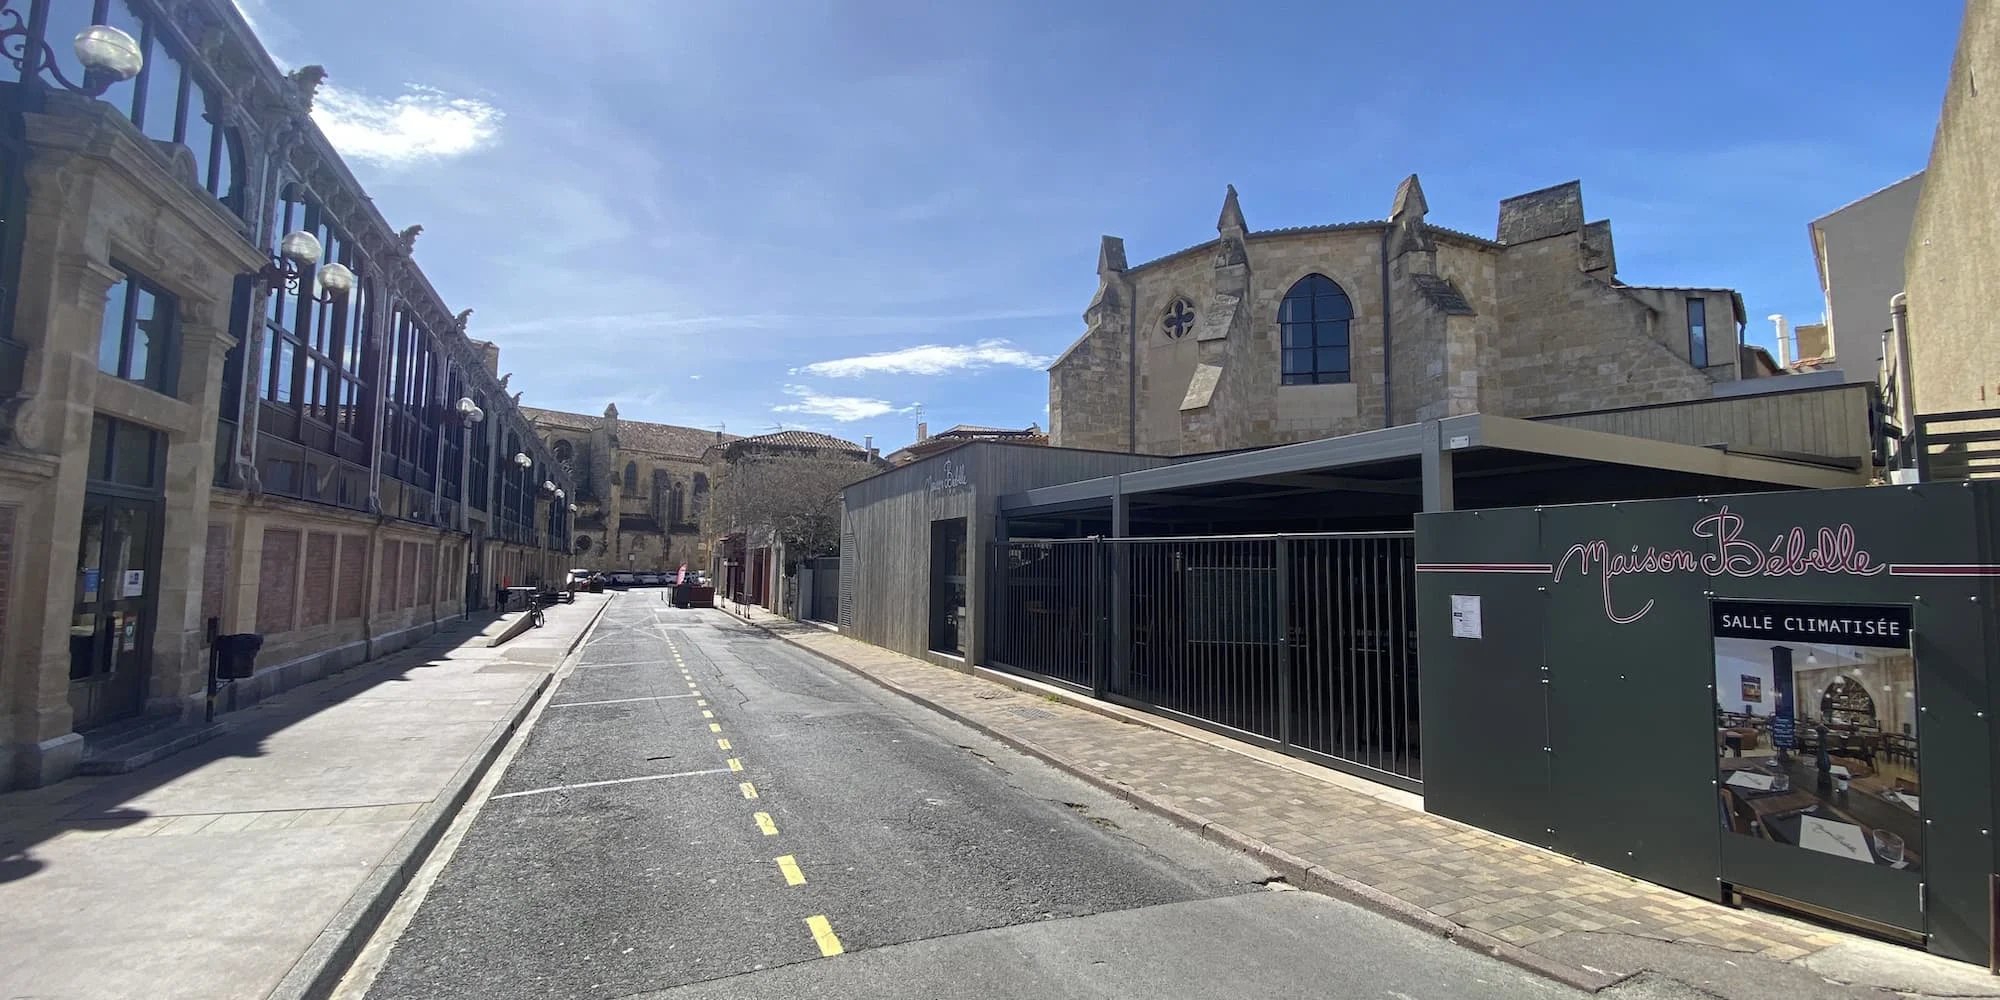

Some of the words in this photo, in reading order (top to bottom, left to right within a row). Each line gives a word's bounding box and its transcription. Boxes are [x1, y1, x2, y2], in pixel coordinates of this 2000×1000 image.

[1554, 540, 1697, 624] Maison
[1693, 505, 1886, 577] Bébelle
[1722, 615, 1773, 630] SALLE
